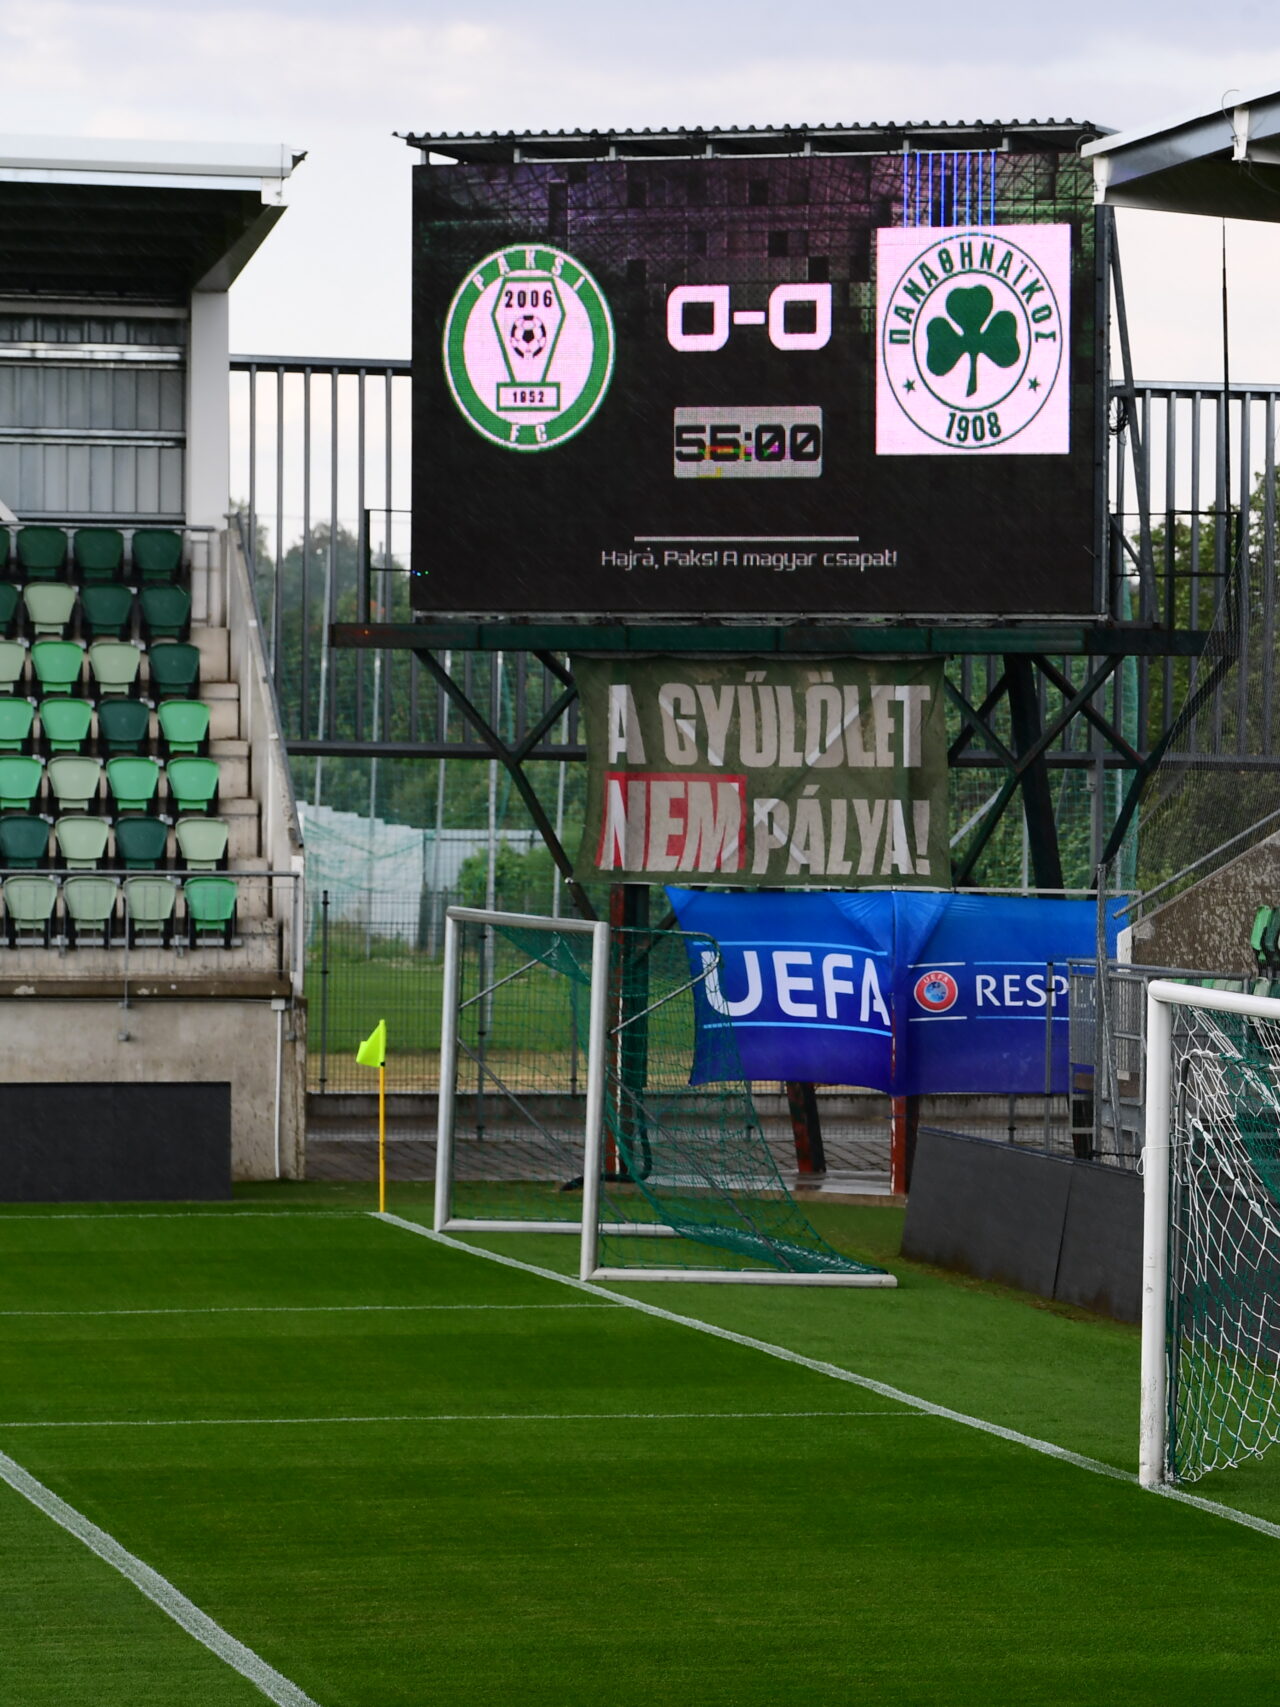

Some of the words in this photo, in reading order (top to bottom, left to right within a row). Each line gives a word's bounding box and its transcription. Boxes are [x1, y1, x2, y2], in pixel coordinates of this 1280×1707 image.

[472, 249, 586, 291] PAKSI
[505, 290, 553, 308] 2006
[510, 424, 547, 442] FC
[946, 412, 1001, 442] 1908
[601, 547, 659, 571] Hajrá,
[664, 550, 718, 567] Paks!
[723, 550, 738, 567] A
[743, 552, 817, 572] magyar
[823, 549, 897, 573] csapat!
[608, 684, 646, 765] A
[658, 670, 931, 768] GYŰLÖLET
[600, 779, 742, 873] NEM
[751, 784, 931, 876] PÁLYA!
[701, 950, 892, 1026] UEFA
[922, 973, 949, 983] UEFA
